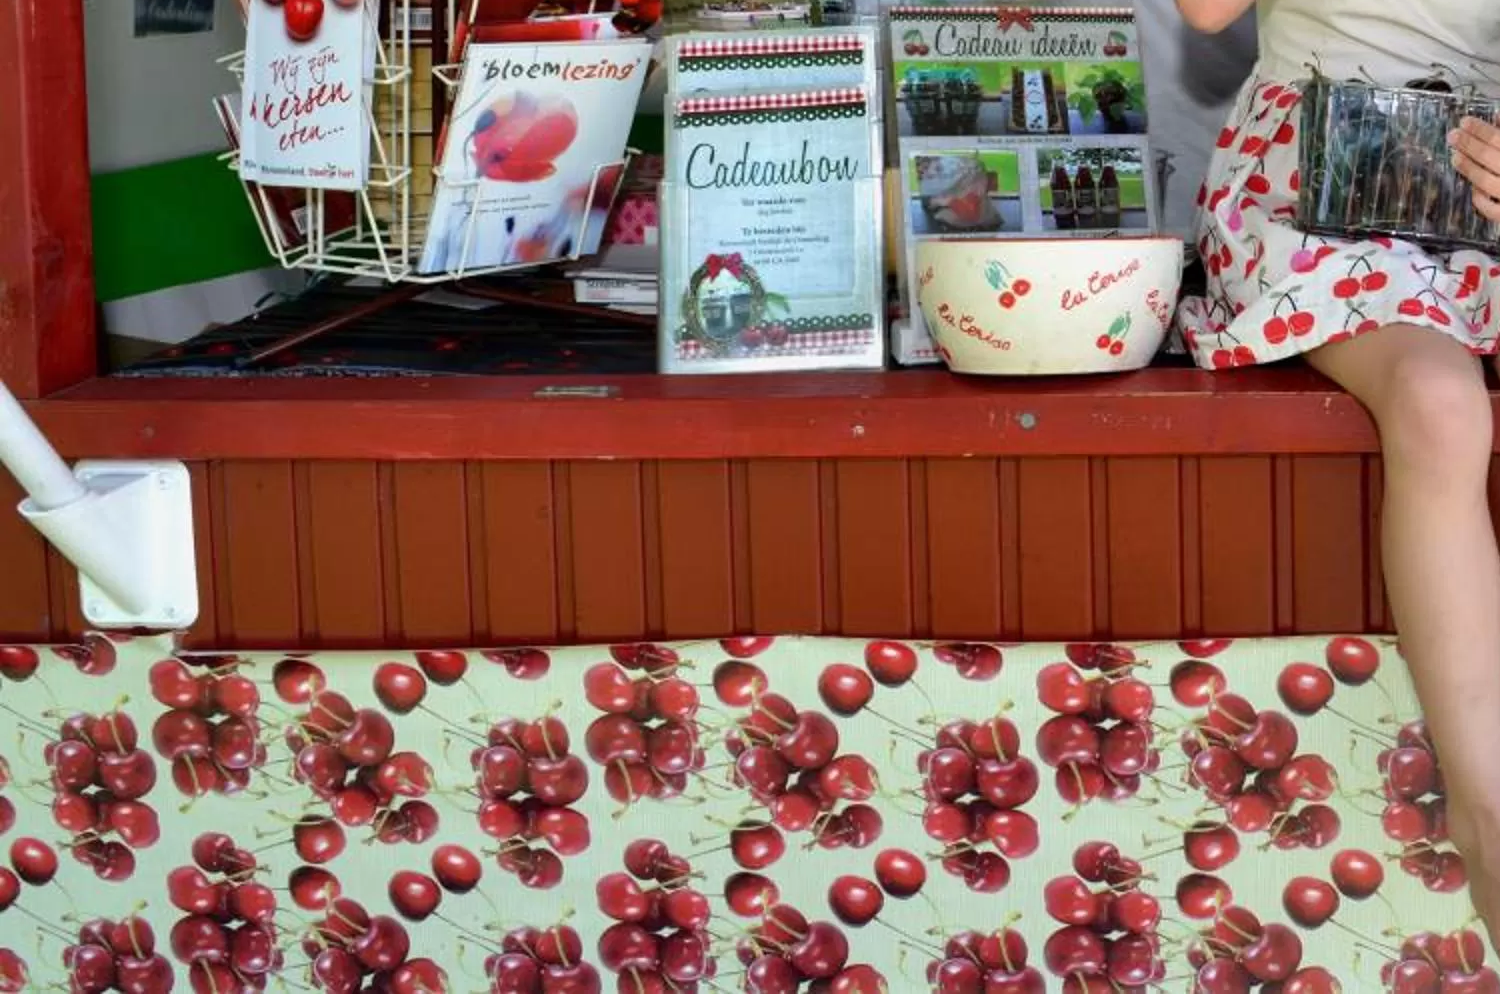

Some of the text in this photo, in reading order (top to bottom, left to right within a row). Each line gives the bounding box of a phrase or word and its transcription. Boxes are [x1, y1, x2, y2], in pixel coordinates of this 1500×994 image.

[934, 23, 1098, 57] Cadeau ideeën
[263, 82, 353, 129] kersen
[686, 139, 859, 190] Cadeaubon
